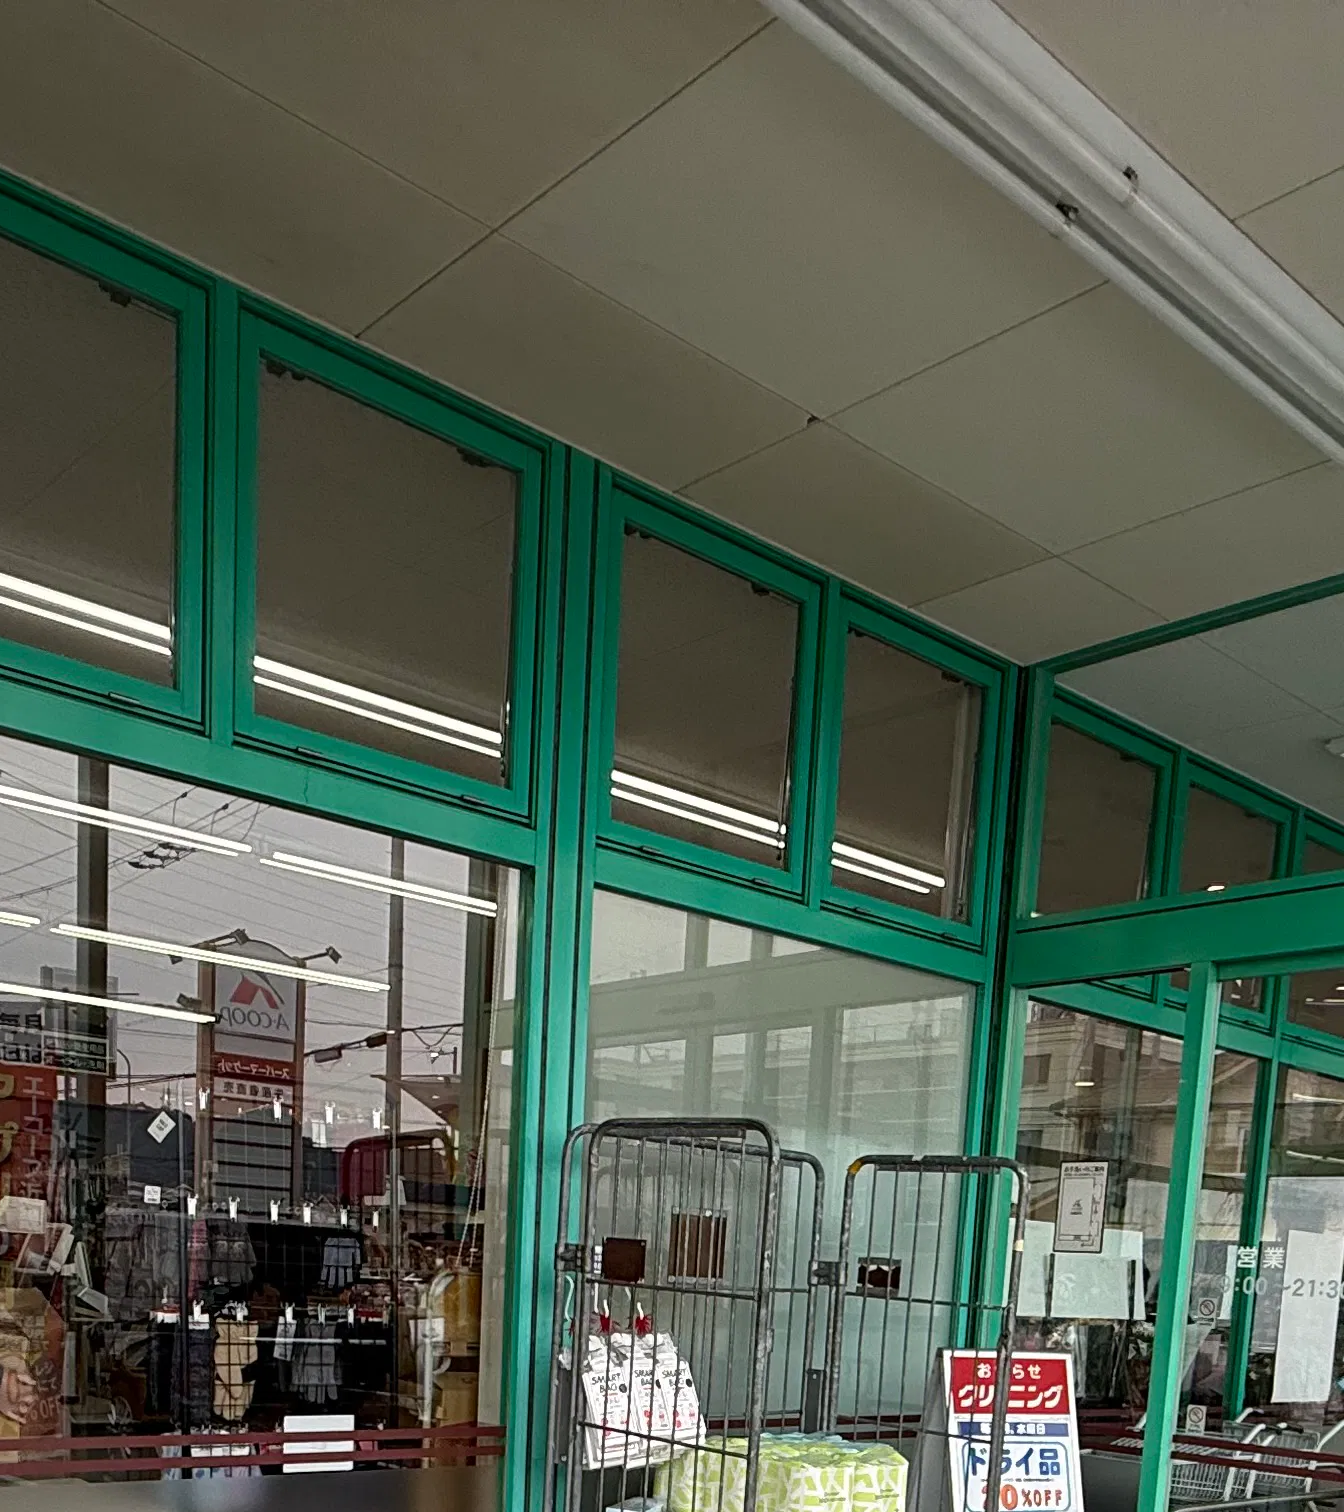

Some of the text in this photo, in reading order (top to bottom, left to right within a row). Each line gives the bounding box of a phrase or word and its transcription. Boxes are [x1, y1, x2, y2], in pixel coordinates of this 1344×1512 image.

[977, 1363, 1041, 1379] おらせ
[958, 1384, 1063, 1408] クリニング
